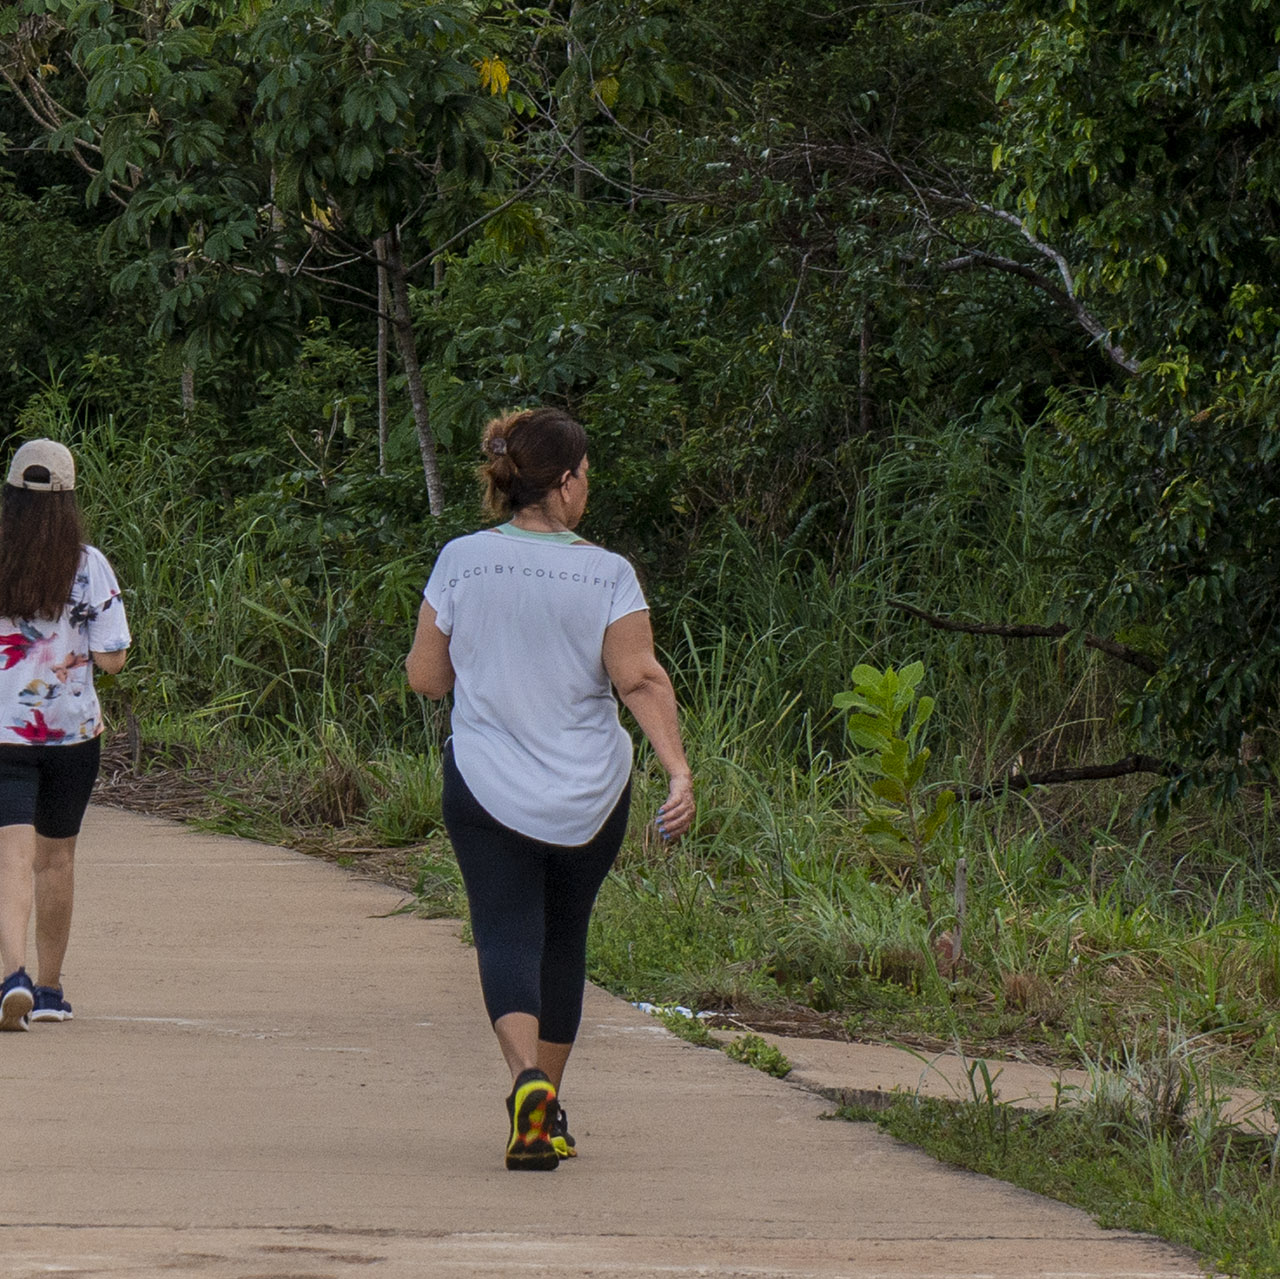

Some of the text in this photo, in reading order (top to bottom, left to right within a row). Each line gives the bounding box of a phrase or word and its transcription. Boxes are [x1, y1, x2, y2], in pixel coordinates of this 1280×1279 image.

[494, 564, 515, 574] BY
[522, 567, 587, 584] COLCCI
[593, 577, 616, 589] FIT
